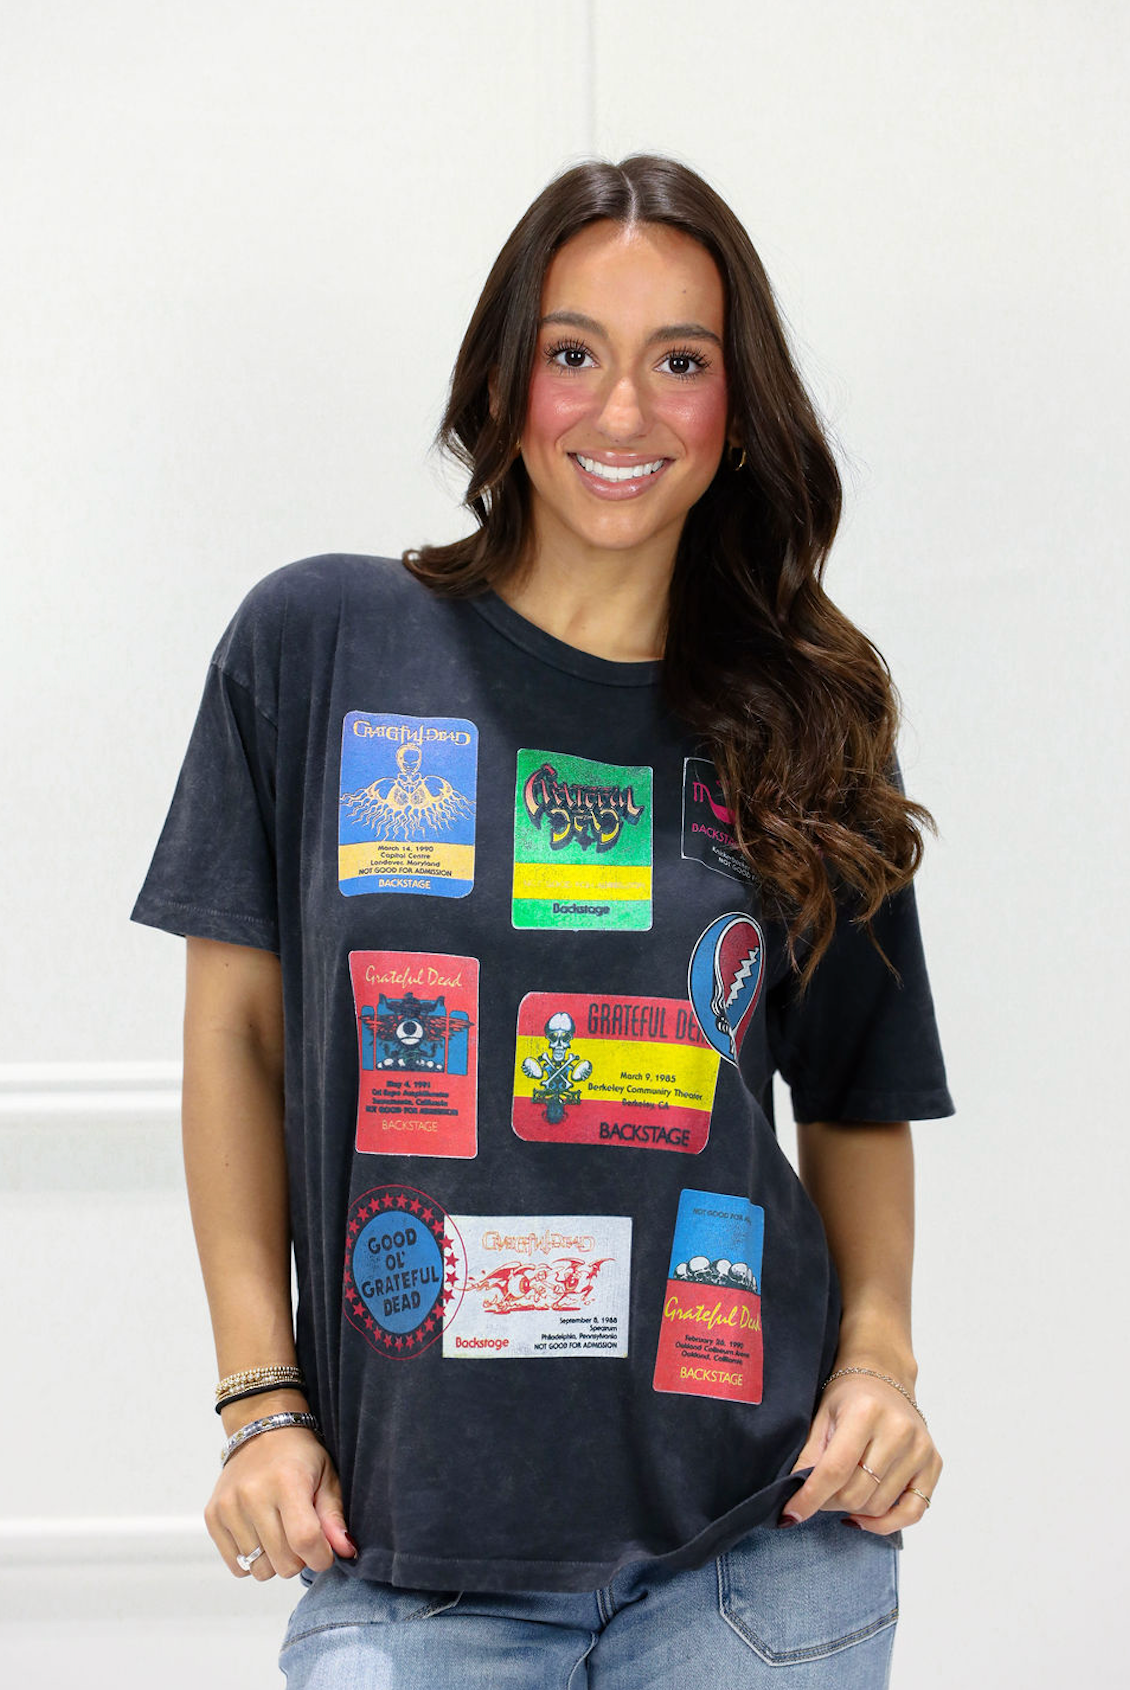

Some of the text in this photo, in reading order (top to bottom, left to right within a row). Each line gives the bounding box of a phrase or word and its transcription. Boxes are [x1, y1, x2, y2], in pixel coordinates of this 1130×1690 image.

[691, 822, 740, 851] BACKSTA
[374, 866, 398, 874] GOOD
[414, 868, 452, 876] ADMISSION
[378, 878, 431, 890] BACKSTAGE
[552, 902, 610, 917] Backstage
[365, 964, 462, 989] Grateful Dead
[587, 1003, 705, 1043] GRATEFUL DEA
[620, 1071, 676, 1083] March 9, 1985
[588, 1082, 703, 1101] Berkeley Community Theater
[658, 1100, 669, 1110] CA
[382, 1119, 438, 1132] BACKSTAGE
[600, 1122, 690, 1147] BACKSTAGE
[706, 1209, 729, 1219] GOOD
[368, 1227, 418, 1255] GOOD
[385, 1251, 406, 1270] OL'
[361, 1265, 440, 1299] GRATEFUL
[383, 1290, 421, 1318] DEAD
[559, 1317, 592, 1325] September
[601, 1316, 618, 1324] 1988
[664, 1296, 737, 1330] Grateful
[590, 1324, 618, 1332] Spectrum
[455, 1336, 510, 1351] Backstage
[579, 1332, 618, 1341] Pennsylvania
[685, 1334, 713, 1346] February
[548, 1342, 568, 1350] GOOD
[583, 1341, 618, 1349] ADMISSION
[675, 1341, 702, 1351] Oakland
[680, 1366, 743, 1386] BACKSTAGE
